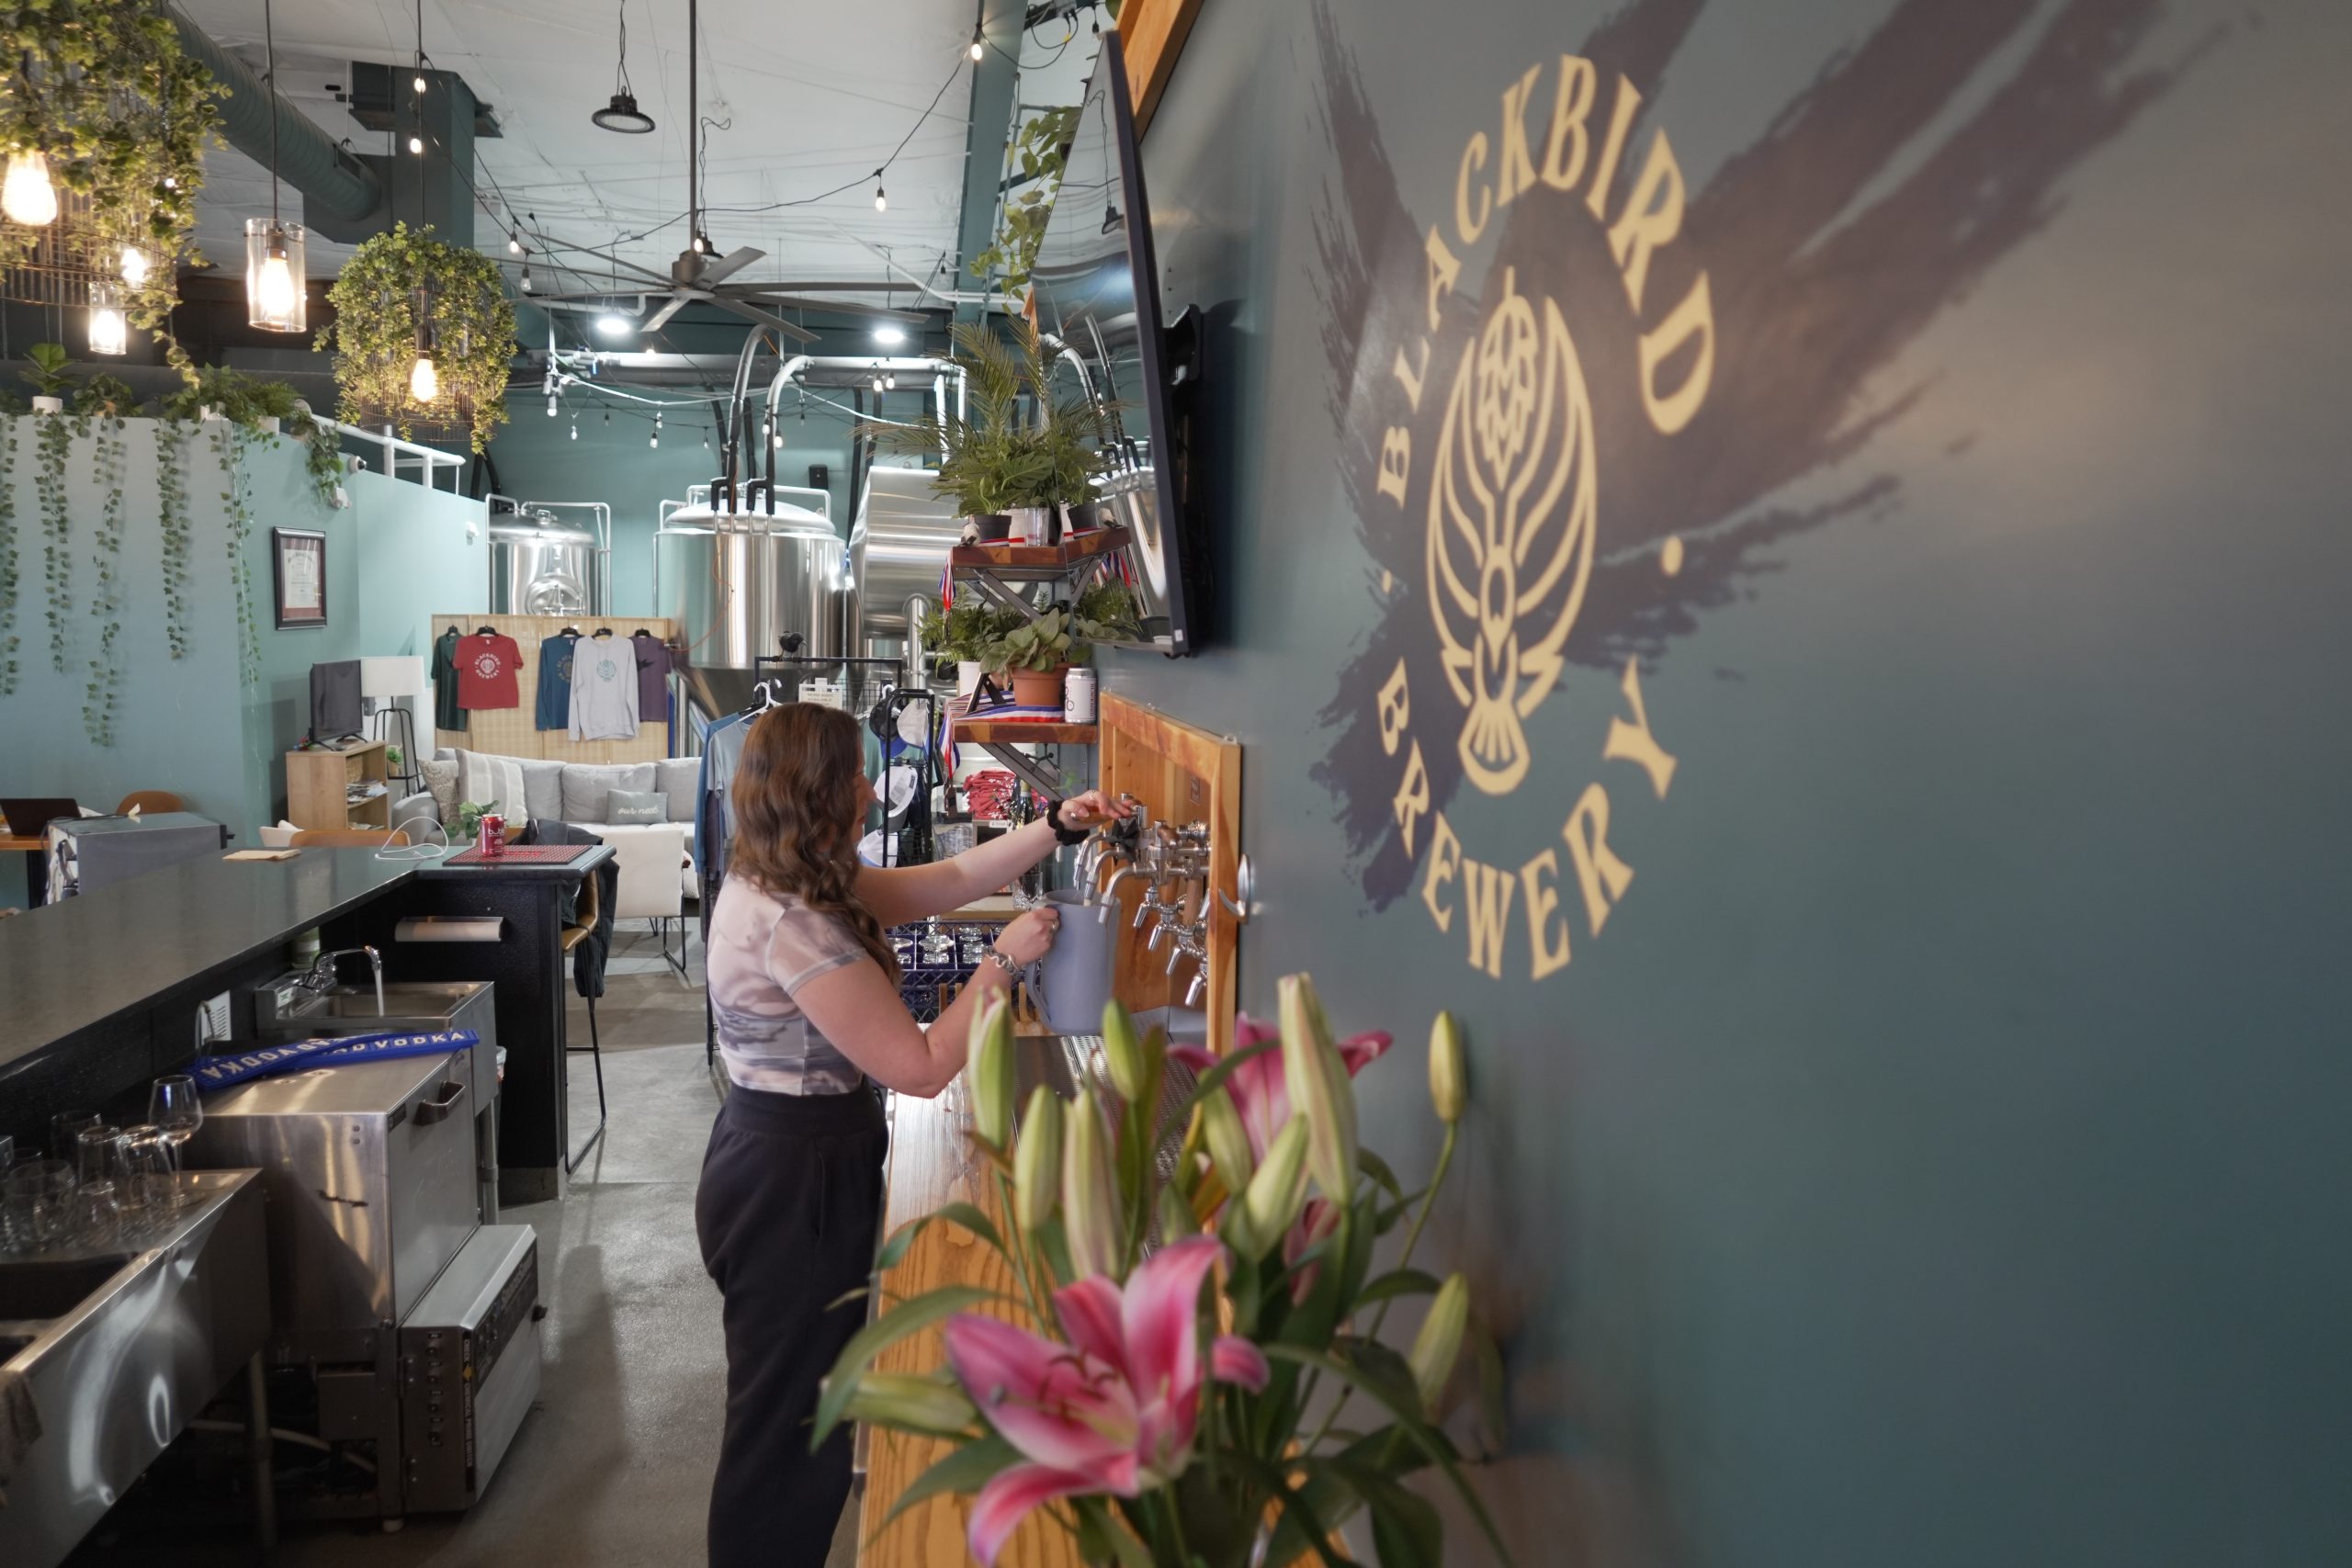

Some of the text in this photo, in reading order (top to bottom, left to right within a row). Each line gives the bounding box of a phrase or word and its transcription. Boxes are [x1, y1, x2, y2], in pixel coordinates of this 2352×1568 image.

[1377, 53, 1714, 509] BLACKBIRD
[1377, 656, 1677, 981] BREWERY
[200, 1048, 295, 1079] VODKA
[375, 1031, 465, 1048] VODKA
